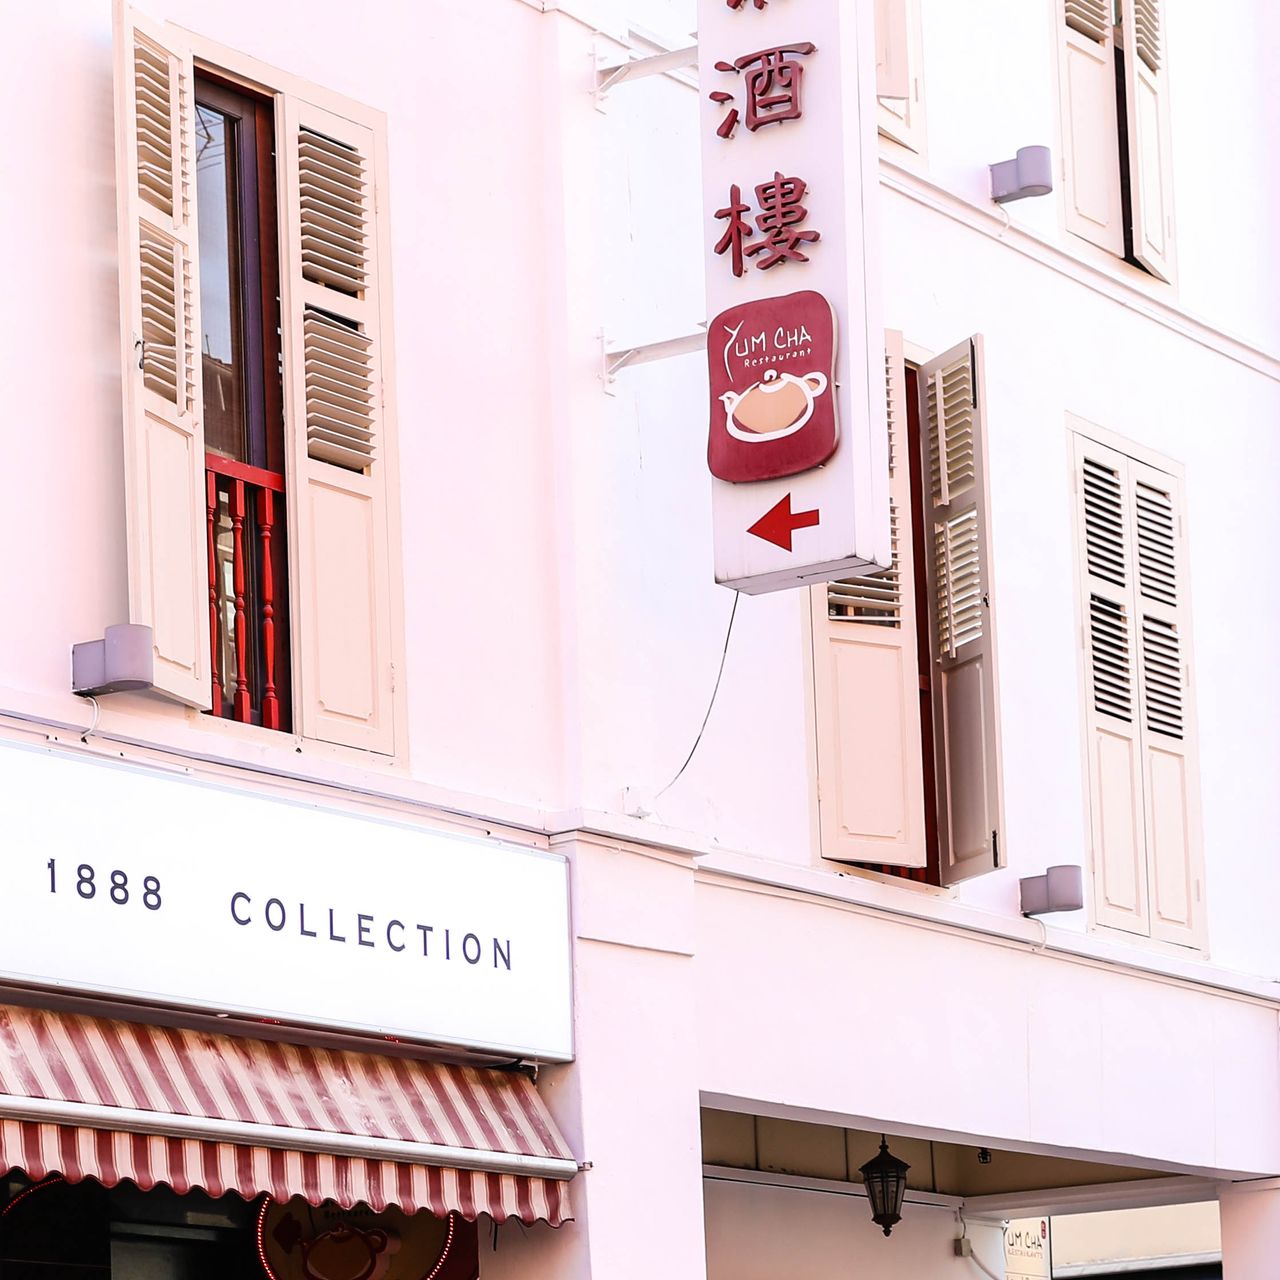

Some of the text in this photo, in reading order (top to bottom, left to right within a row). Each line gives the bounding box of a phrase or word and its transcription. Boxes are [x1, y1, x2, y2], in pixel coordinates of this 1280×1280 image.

[709, 0, 821, 278] 酒樓
[724, 320, 812, 383] YUM CHA
[743, 347, 813, 369] Restaurant
[46, 858, 163, 911] 1888
[230, 890, 514, 971] COLLECTION
[1024, 1231, 1043, 1249] CHA
